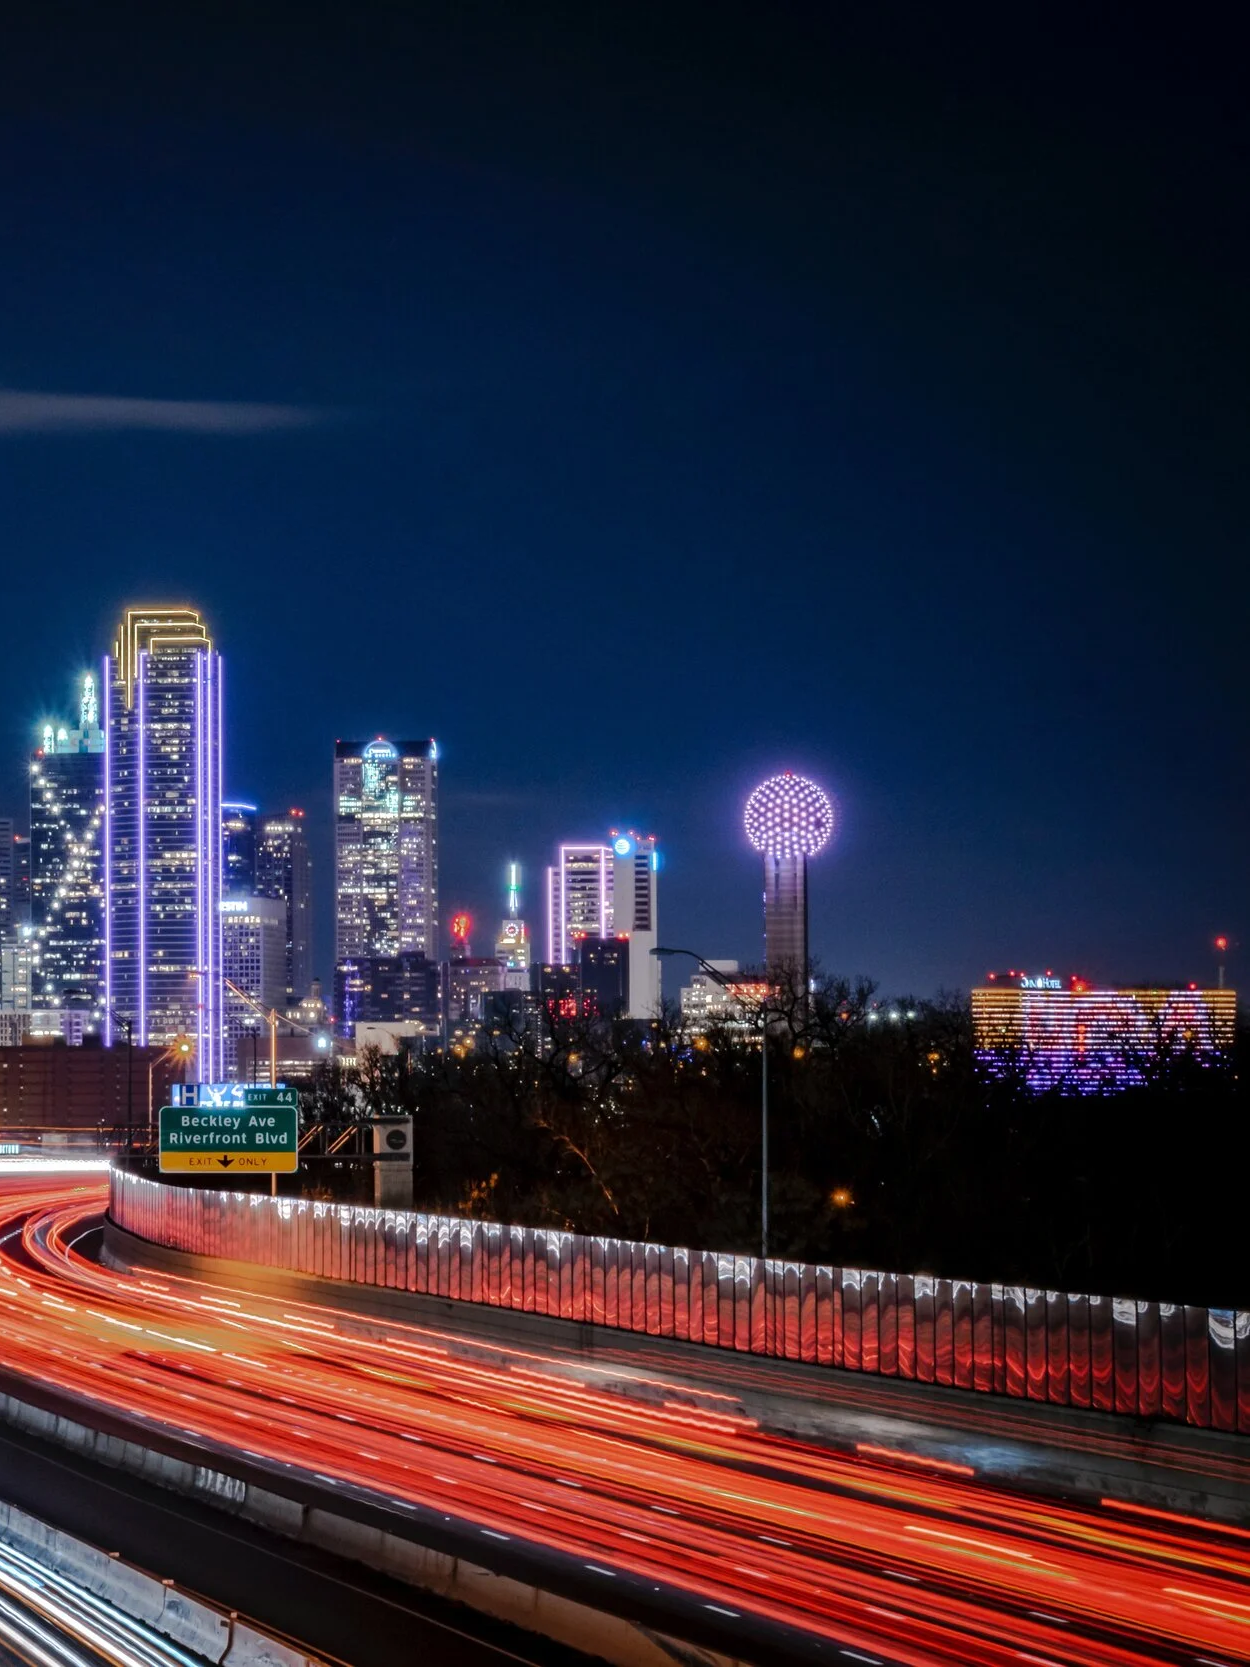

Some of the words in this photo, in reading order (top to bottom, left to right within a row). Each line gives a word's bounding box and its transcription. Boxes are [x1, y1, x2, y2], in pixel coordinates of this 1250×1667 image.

[181, 1085, 198, 1105] H
[247, 1093, 267, 1101] EXIT
[276, 1092, 292, 1102] 44
[181, 1115, 241, 1130] Beckley
[248, 1115, 276, 1127] Ave
[169, 1132, 247, 1144] Riverfront
[255, 1132, 288, 1144] Blvd
[189, 1158, 212, 1166] EXIT
[238, 1158, 267, 1166] ONLY
